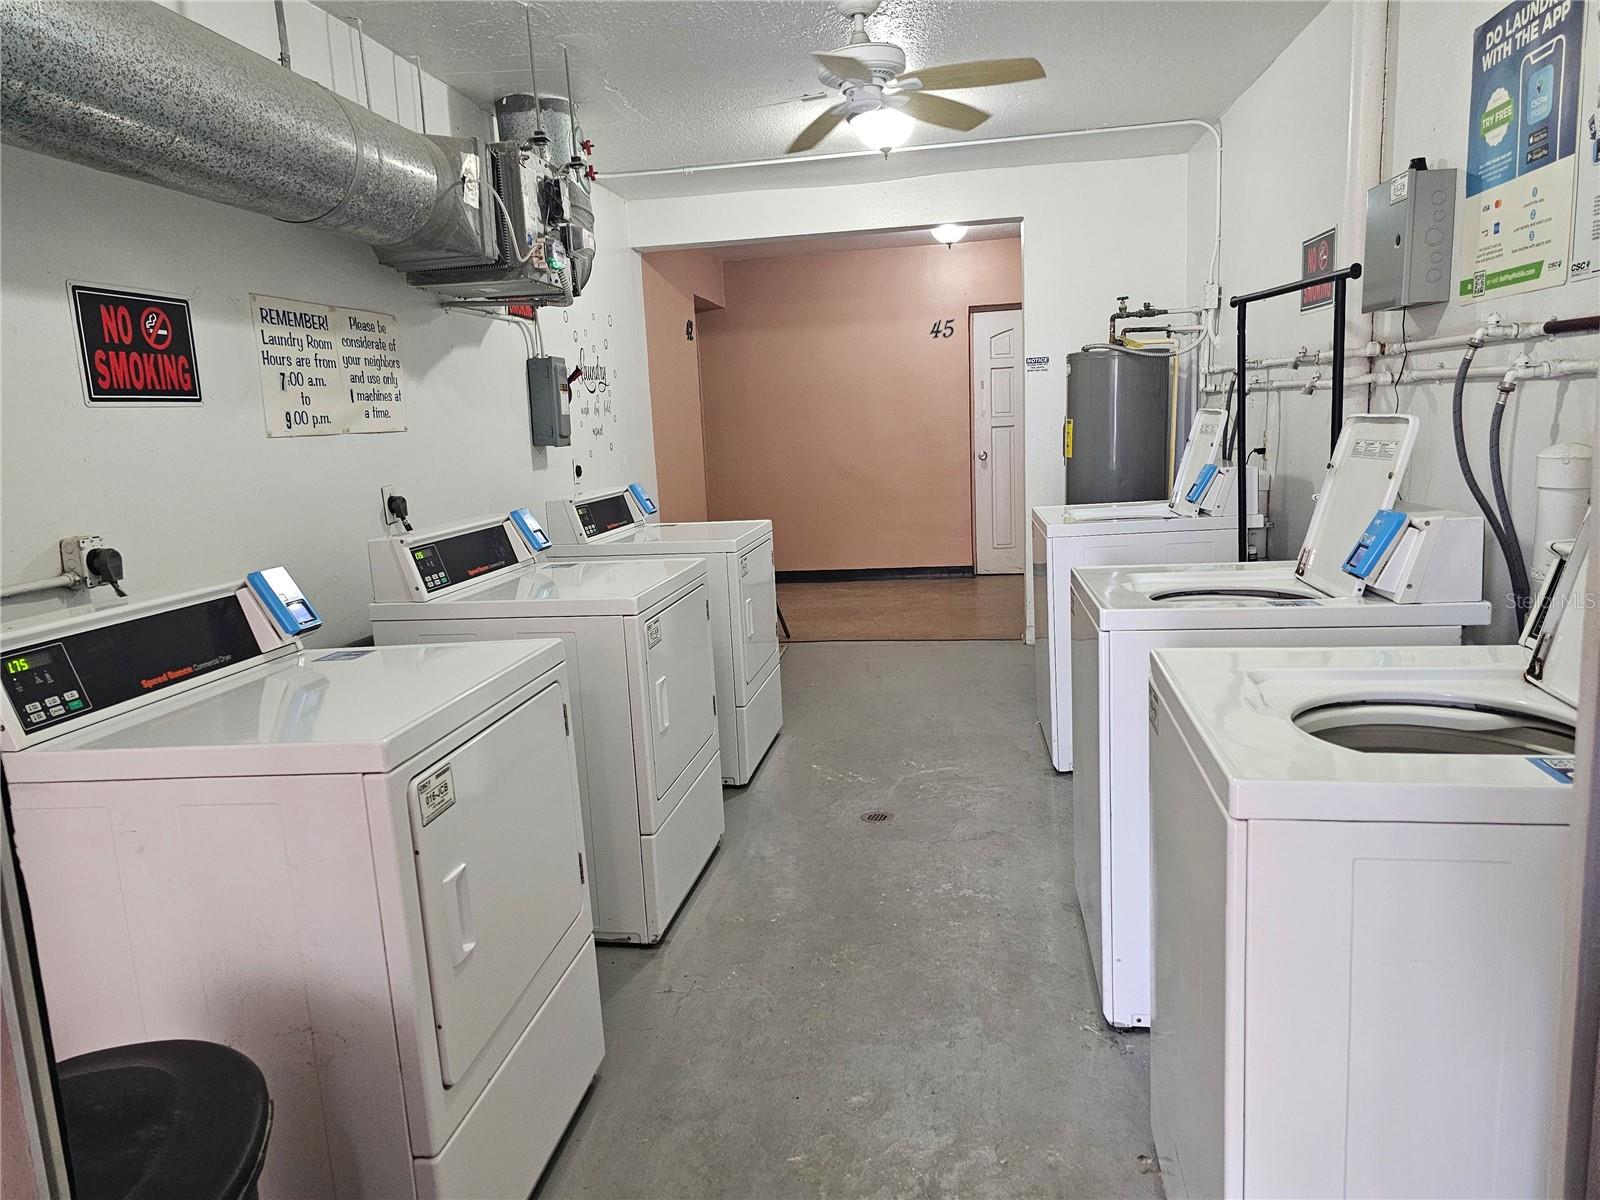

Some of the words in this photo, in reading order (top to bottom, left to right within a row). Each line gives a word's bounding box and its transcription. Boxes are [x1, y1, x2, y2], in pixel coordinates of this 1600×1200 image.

[1482, 38, 1512, 72] WITH
[1515, 19, 1539, 50] THE
[1542, 0, 1571, 34] APP
[1486, 25, 1503, 50] DO
[1482, 112, 1495, 129] TRY
[1495, 105, 1512, 122] FREE
[1306, 247, 1317, 272] NO
[1571, 261, 1586, 272] CSC
[100, 304, 133, 345] NO
[259, 307, 329, 331] REMEMBER!
[348, 316, 375, 333] Please
[377, 320, 387, 334] be
[930, 319, 955, 339] 45
[261, 330, 304, 351] Laundry
[306, 335, 333, 350] Room
[341, 335, 387, 351] considerate
[388, 338, 396, 352] of
[261, 350, 292, 367] Hours
[295, 357, 311, 368] are
[314, 353, 337, 369] from
[342, 355, 361, 369] your
[364, 354, 400, 371] neighbors
[95, 349, 192, 391] SMOKING
[349, 371, 365, 384] and
[367, 374, 381, 384] use
[382, 372, 398, 388] only
[280, 372, 304, 391] 7:00
[308, 377, 327, 387] a.m.
[301, 392, 311, 405] to
[357, 388, 393, 402] machines
[394, 390, 401, 402] at
[312, 415, 332, 428] p.m.
[364, 409, 370, 418] a
[372, 406, 391, 419] time.
